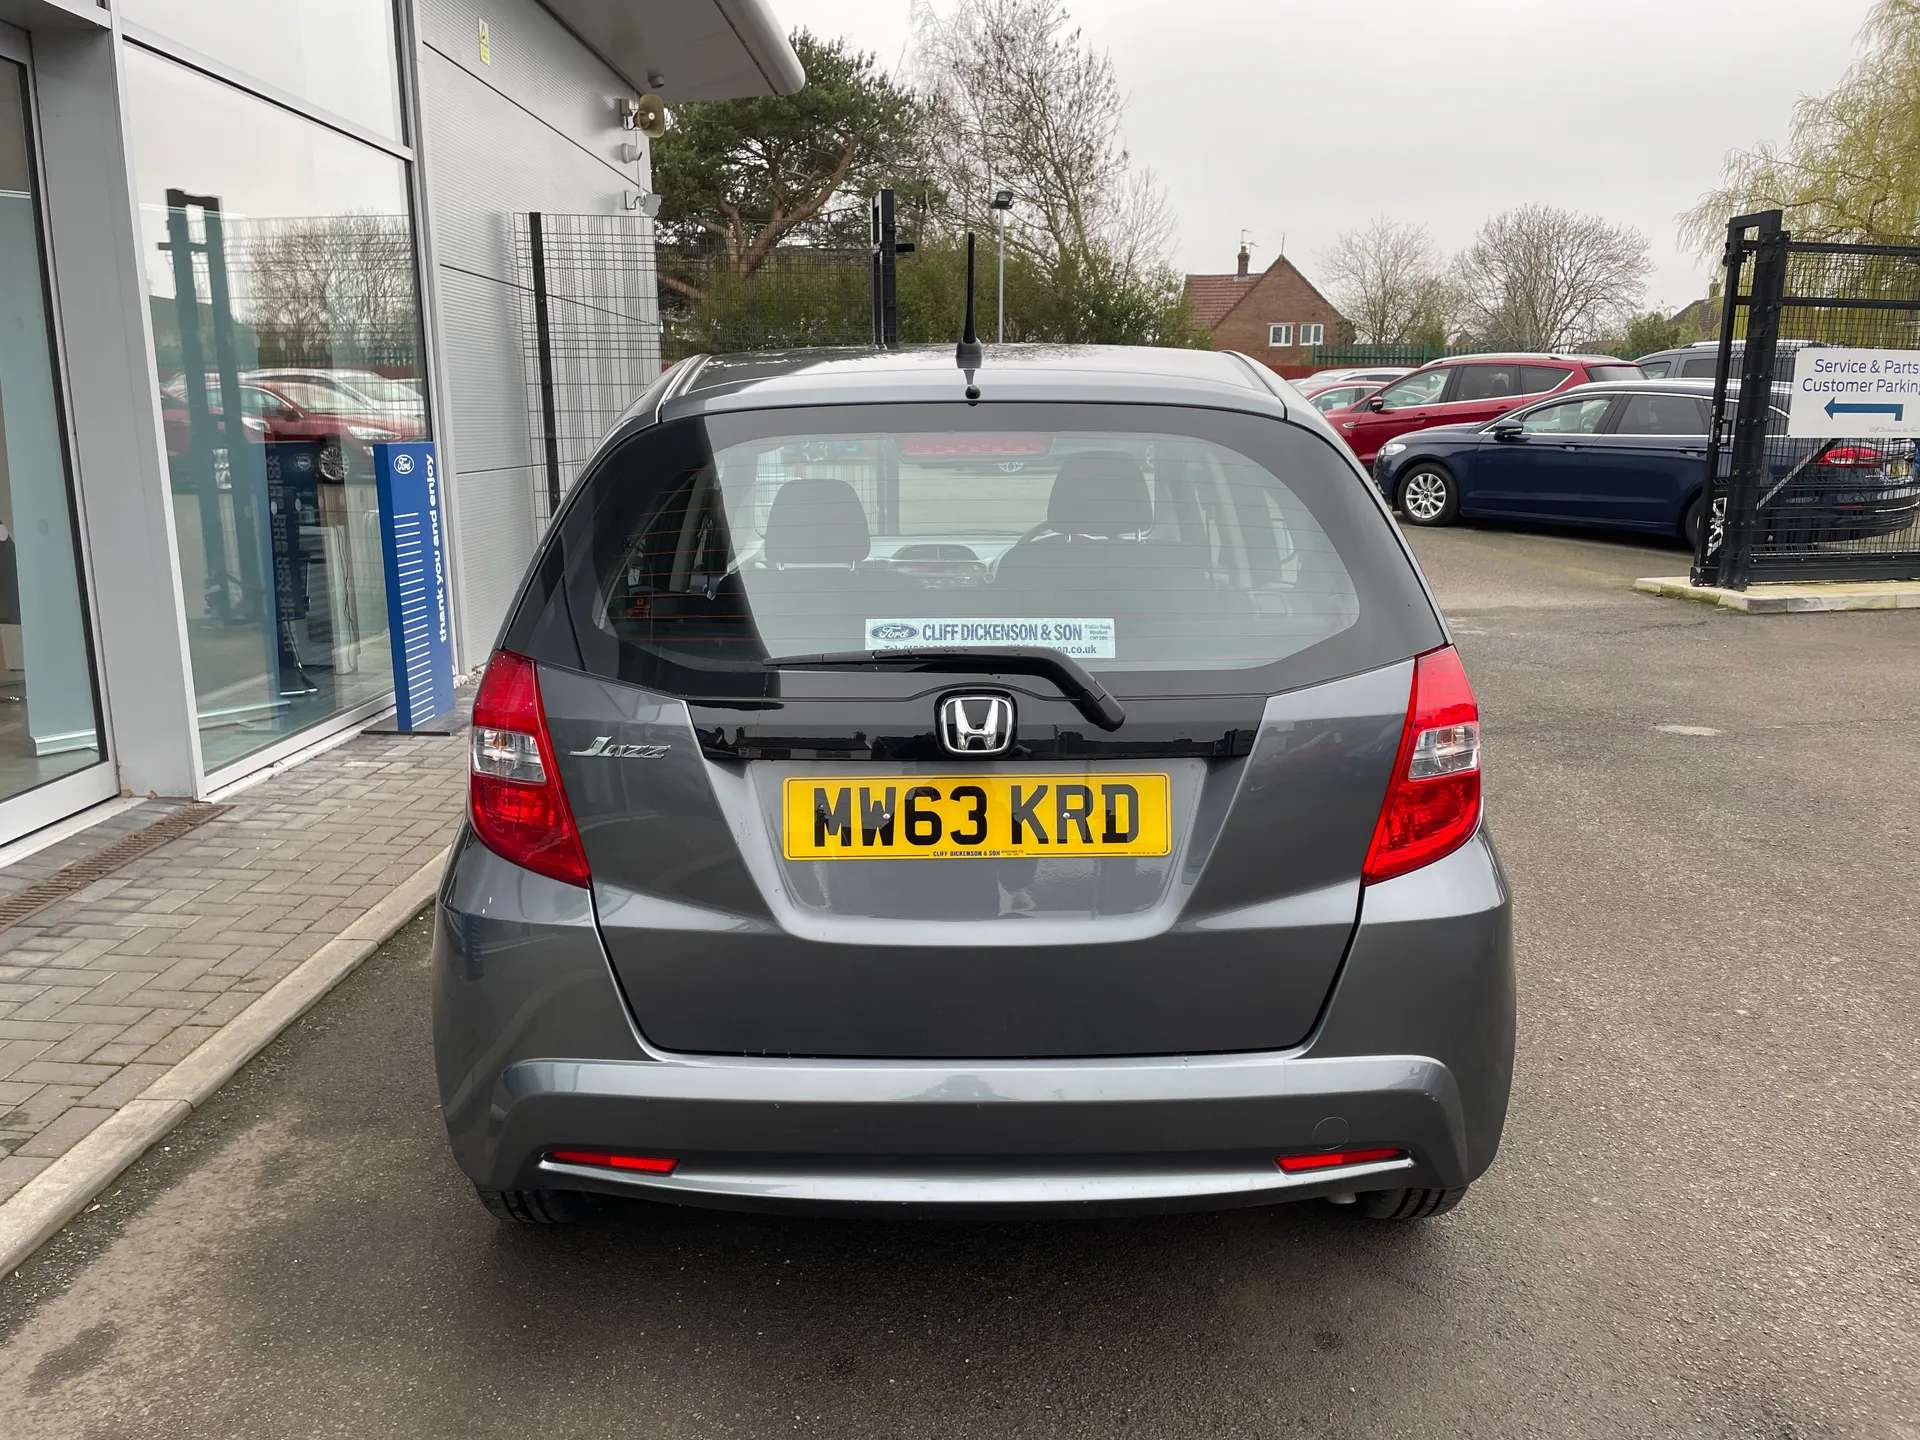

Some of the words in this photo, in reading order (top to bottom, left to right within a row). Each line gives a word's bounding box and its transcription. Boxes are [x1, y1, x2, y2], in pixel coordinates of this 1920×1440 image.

[1814, 359, 1867, 374] Service
[1870, 360, 1881, 374] &
[1884, 360, 1919, 375] Parts
[1802, 378, 1873, 393] Customer
[425, 453, 436, 507] enjoy
[429, 510, 440, 548] and
[434, 551, 444, 585] you
[437, 586, 447, 643] thank
[922, 624, 959, 641] CLIFF
[961, 624, 1038, 641] DICKENSON
[1040, 624, 1052, 641] &
[1054, 624, 1082, 641] SON
[568, 735, 672, 760] Jazz
[812, 785, 988, 848] MW63
[1010, 784, 1140, 845] KRD
